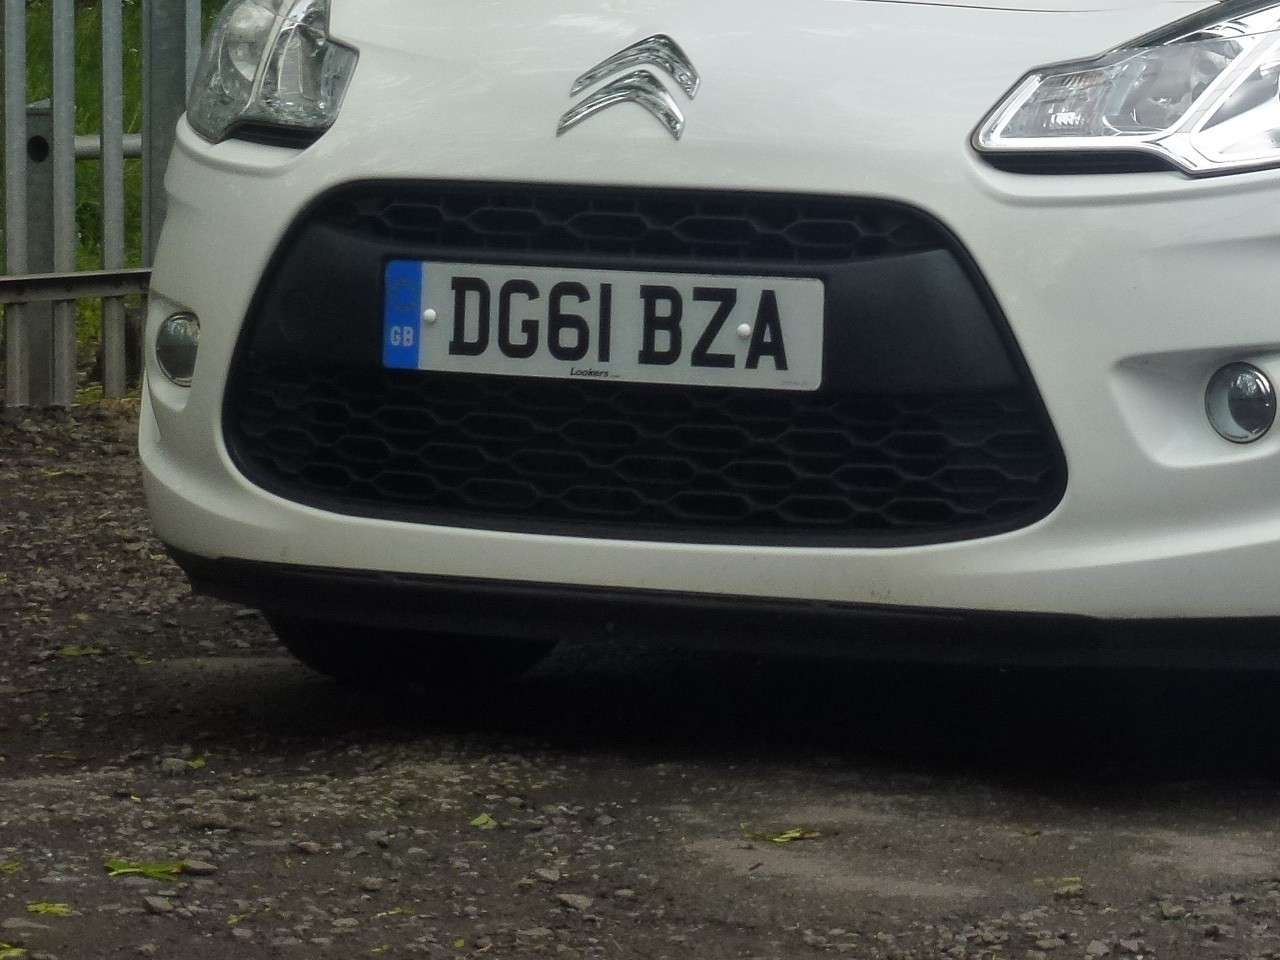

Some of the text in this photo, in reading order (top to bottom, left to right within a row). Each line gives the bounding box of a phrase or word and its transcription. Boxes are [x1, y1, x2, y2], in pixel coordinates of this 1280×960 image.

[390, 326, 414, 347] GB
[448, 276, 789, 371] DG61 BZA
